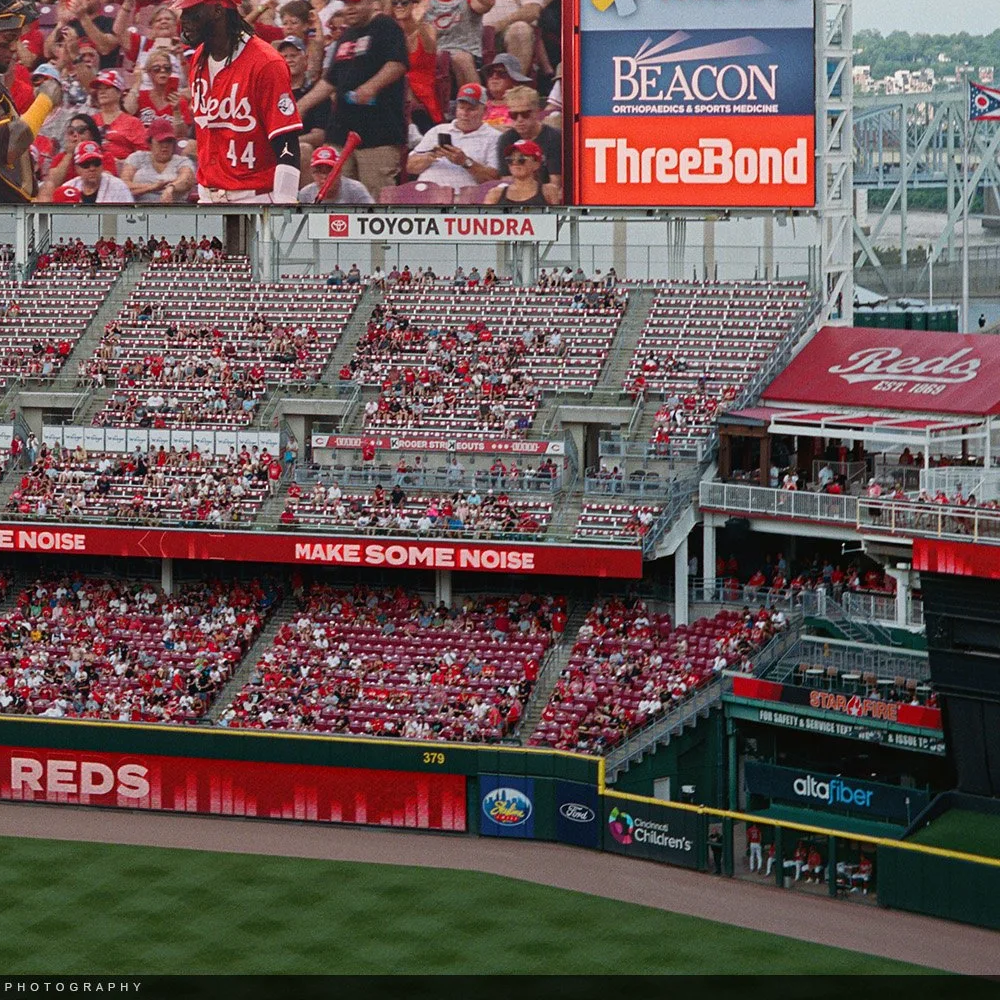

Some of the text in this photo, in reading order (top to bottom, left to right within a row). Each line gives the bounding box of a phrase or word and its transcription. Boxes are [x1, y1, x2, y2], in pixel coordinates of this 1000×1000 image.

[612, 56, 779, 101] BEACON
[192, 78, 257, 131] Reds
[612, 104, 685, 114] ORTHOPAEDICS
[694, 104, 732, 114] SPORTS
[733, 104, 779, 113] MEDICINE
[226, 139, 257, 169] 44
[585, 138, 807, 184] ThreeBond
[357, 217, 535, 236] TOYOTA TUNDRA
[828, 347, 981, 385] Reds
[872, 380, 904, 392] EST.
[18, 531, 86, 550] NOISE
[295, 543, 535, 570] MAKE SOME NOISE
[809, 690, 899, 721] STAR FIRE
[759, 709, 772, 721] FOR
[773, 711, 798, 727] SAFETY
[806, 718, 835, 734] SERVICE
[423, 752, 445, 765] 379
[10, 757, 151, 800] REDS
[793, 775, 874, 808] altafiber
[565, 805, 588, 820] Ford
[634, 828, 692, 852] Children's
